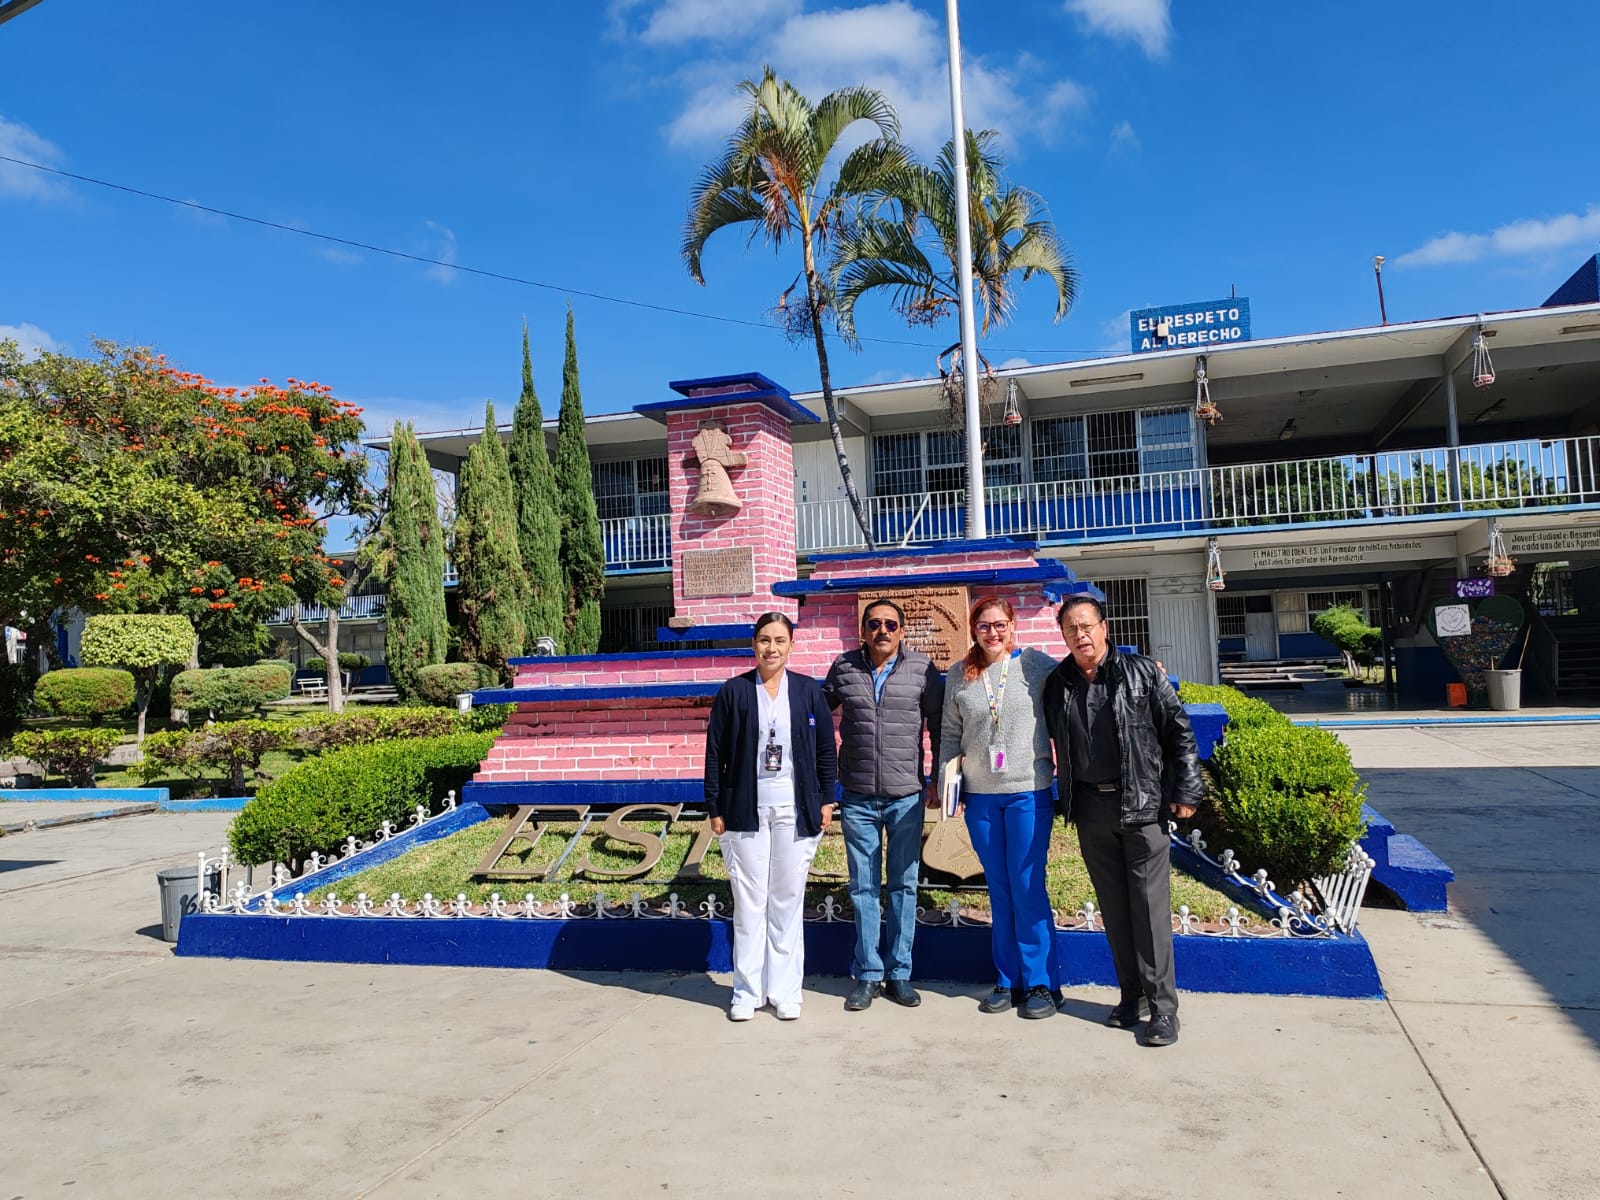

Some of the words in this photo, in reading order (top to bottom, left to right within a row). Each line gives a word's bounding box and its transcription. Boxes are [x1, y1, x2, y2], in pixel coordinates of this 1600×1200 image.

[1138, 317, 1158, 332] EL
[1164, 308, 1239, 329] RESPETO
[1141, 337, 1161, 350] AL
[1167, 327, 1241, 346] DERECHO
[1261, 549, 1290, 558] MAESTRO
